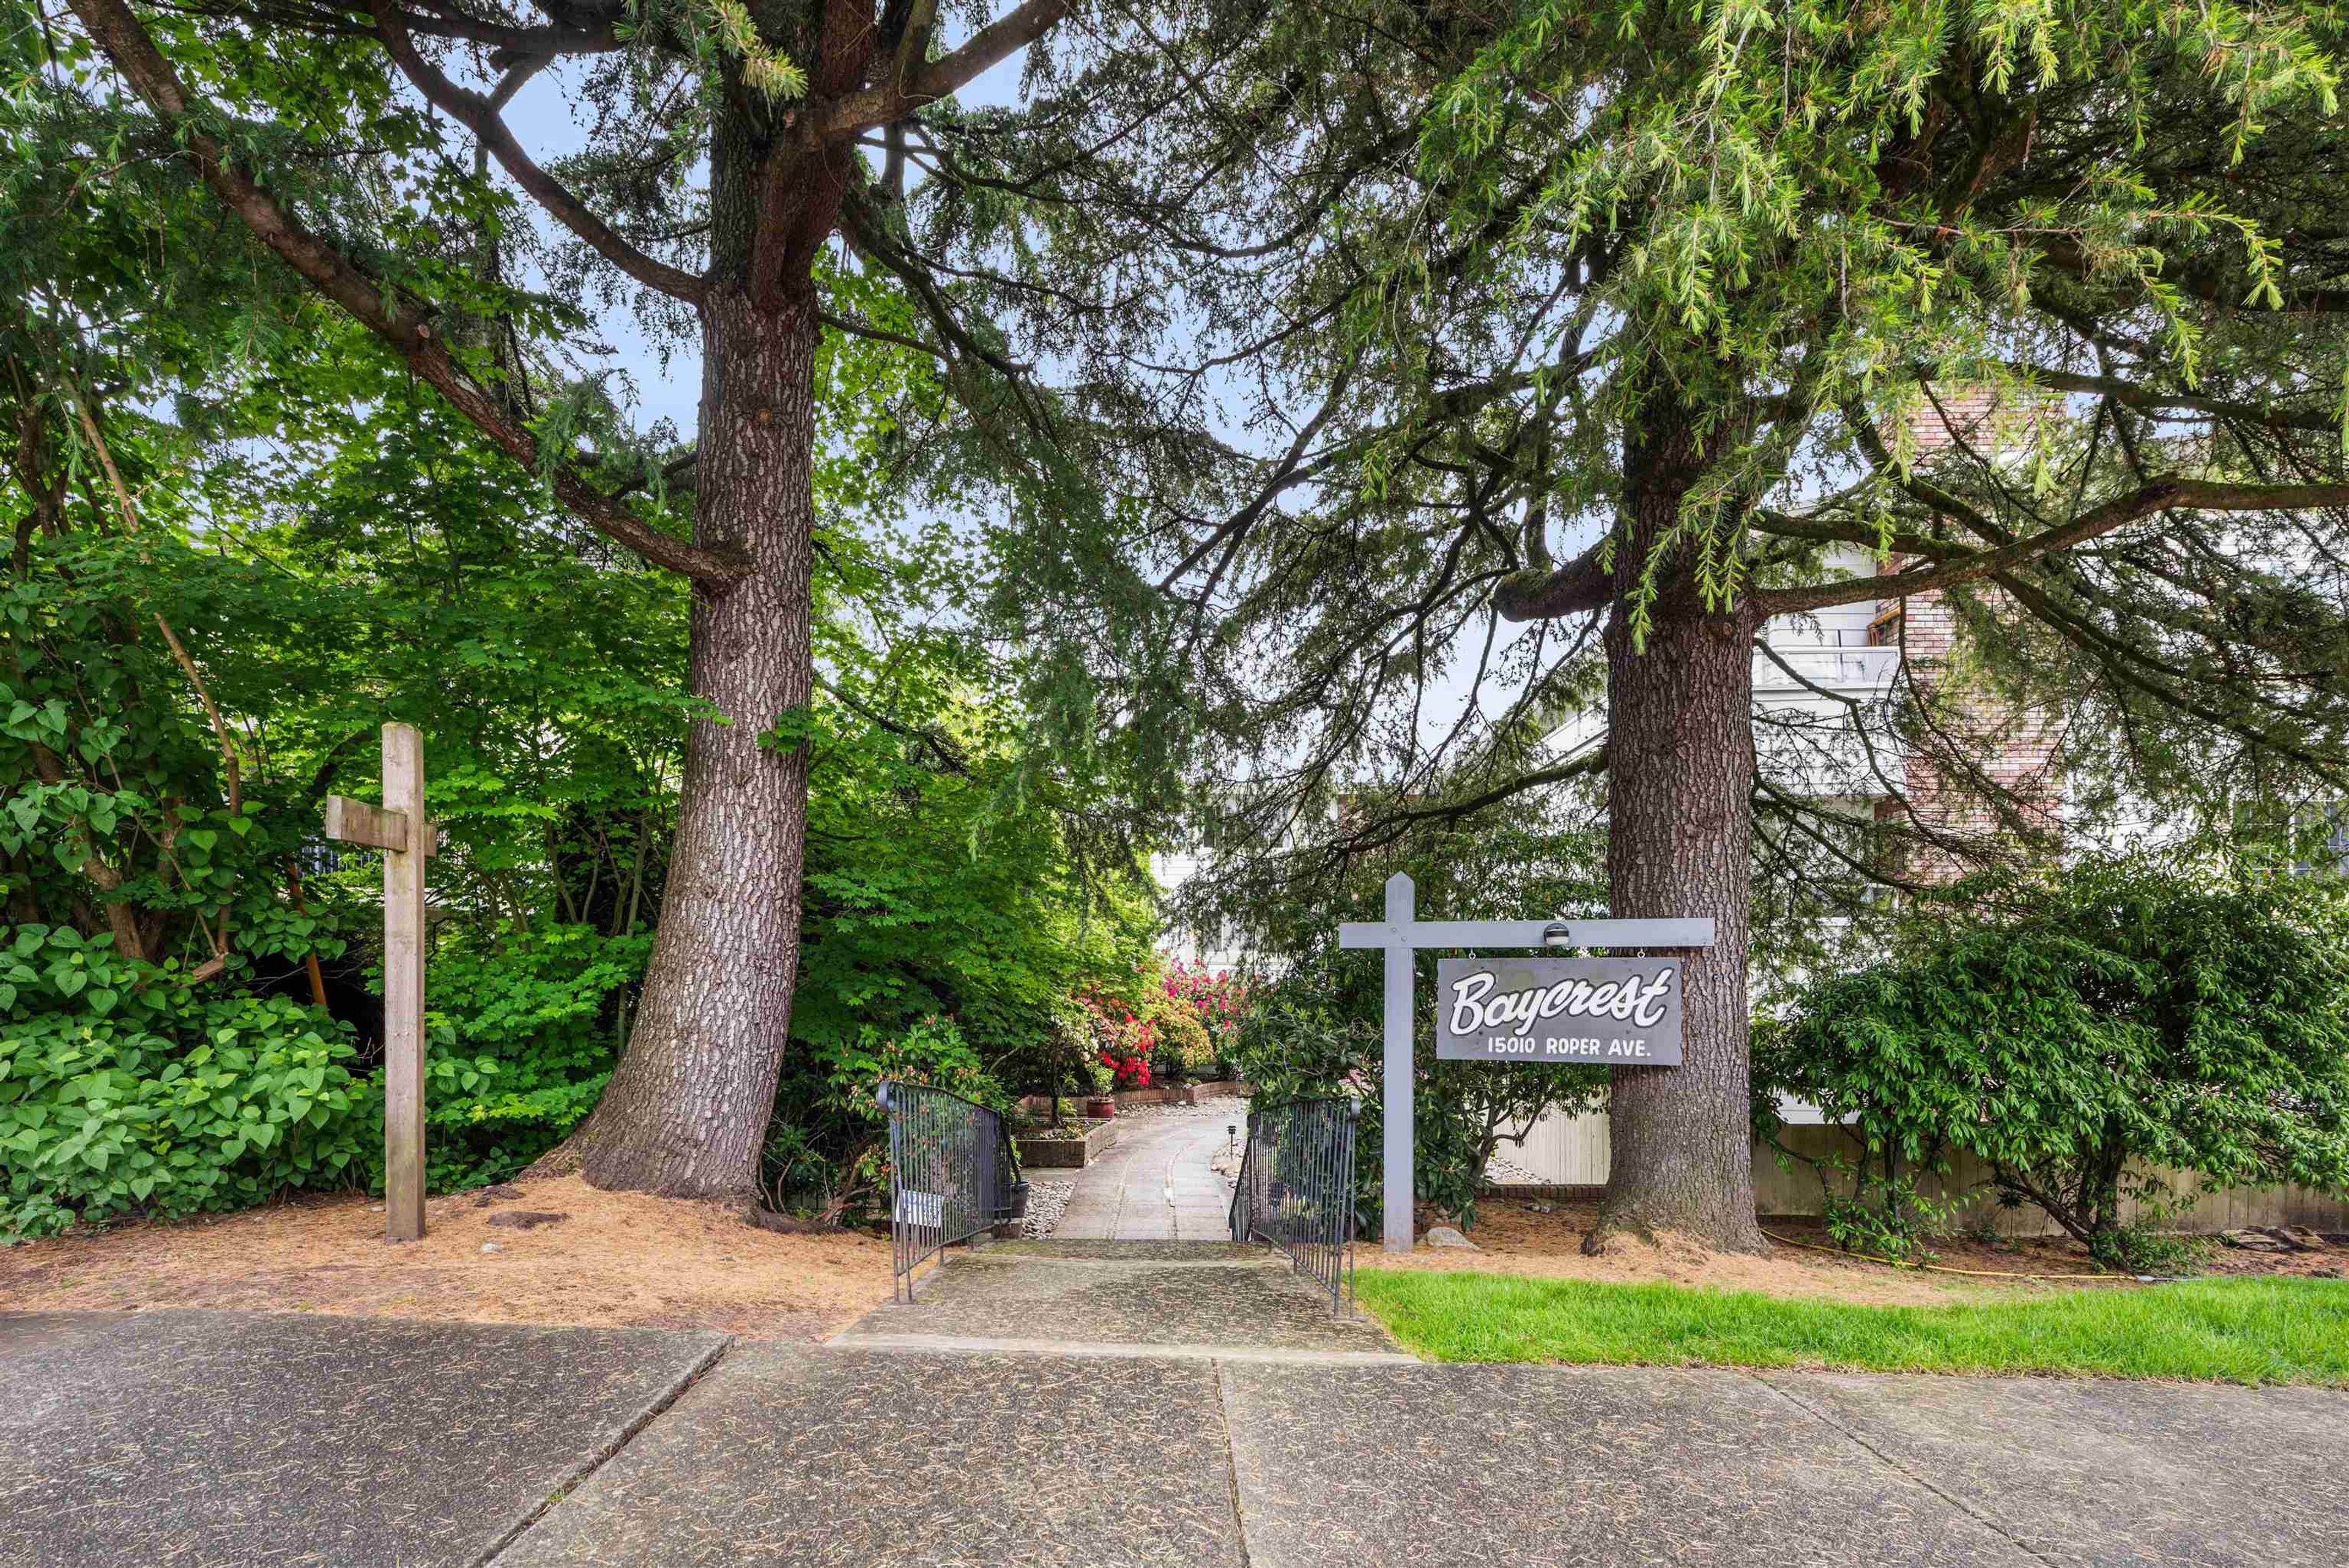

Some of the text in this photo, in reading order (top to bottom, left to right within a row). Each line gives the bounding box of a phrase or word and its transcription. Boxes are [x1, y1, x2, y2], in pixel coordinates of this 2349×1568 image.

[1488, 1036, 1651, 1057] 15010 ROPER AVE.
